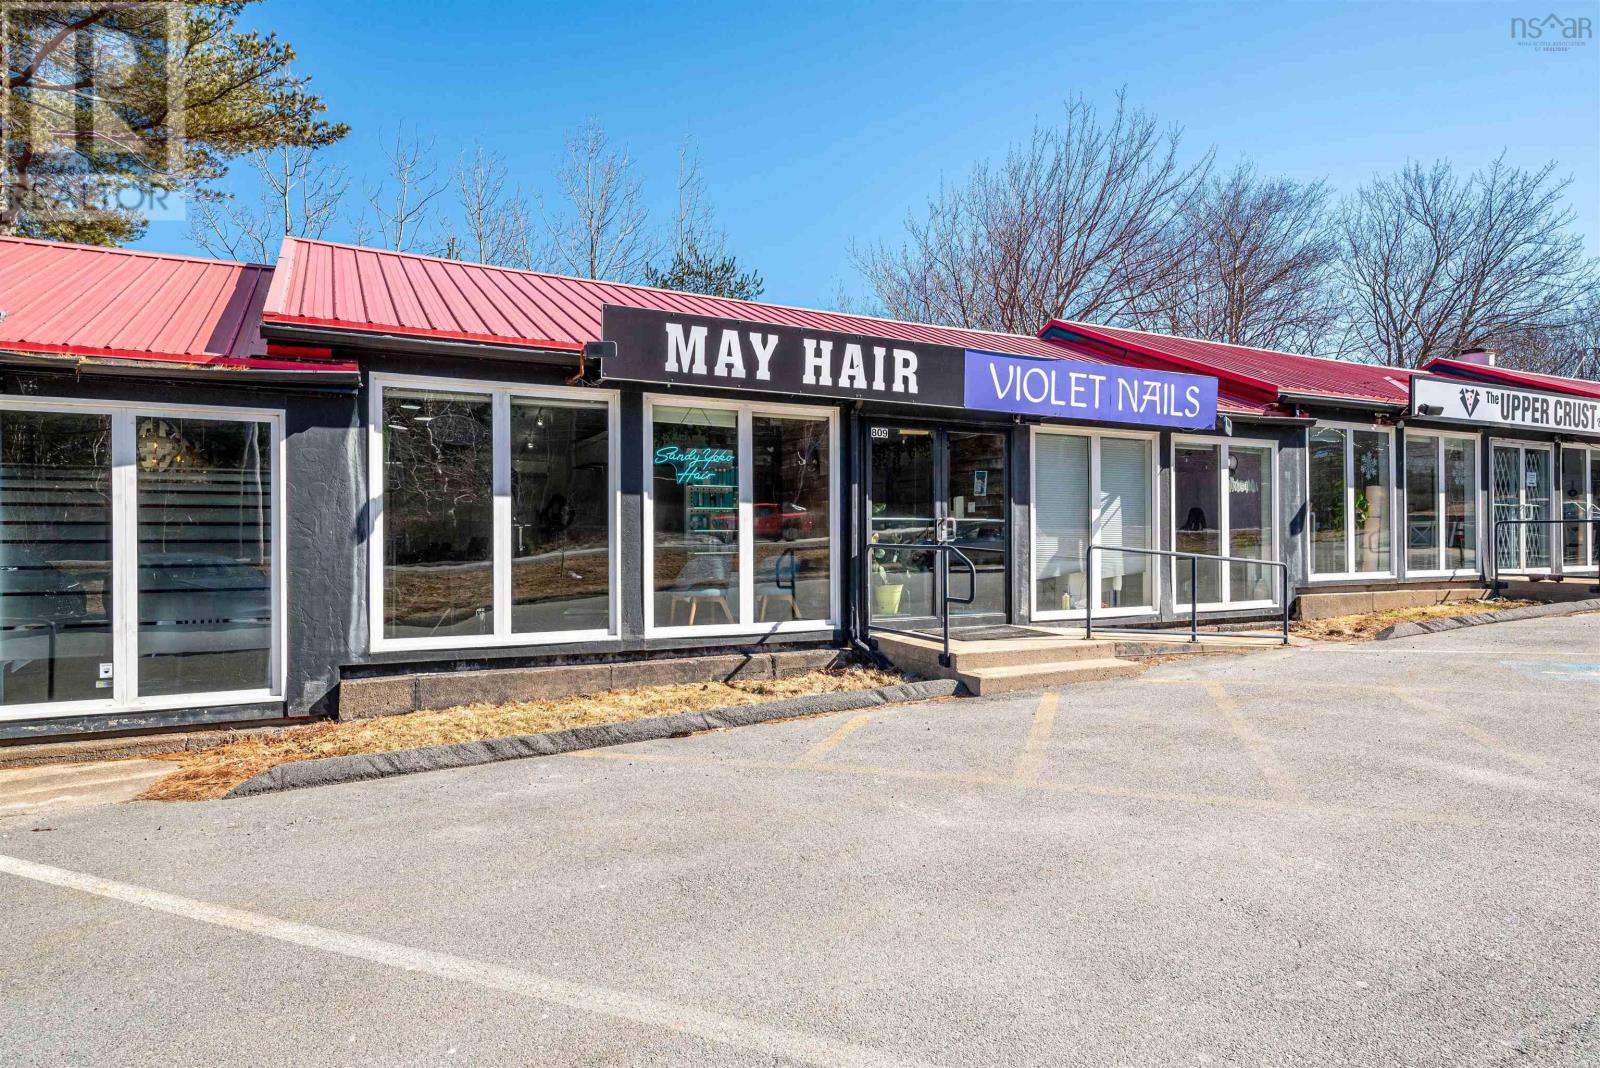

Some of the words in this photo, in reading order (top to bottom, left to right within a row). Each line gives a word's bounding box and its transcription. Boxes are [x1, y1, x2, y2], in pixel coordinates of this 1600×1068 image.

[665, 323, 778, 380] MAY
[803, 338, 919, 394] HAIR
[989, 362, 1107, 409] VIOLET
[1117, 377, 1200, 418] NAILS
[1486, 391, 1500, 405] The
[1501, 394, 1549, 425] UPPER
[1554, 399, 1598, 429] CRUST
[871, 428, 888, 438] 809
[655, 446, 700, 467] Sandy
[702, 447, 735, 470] Yoko
[677, 467, 716, 484] Hair
